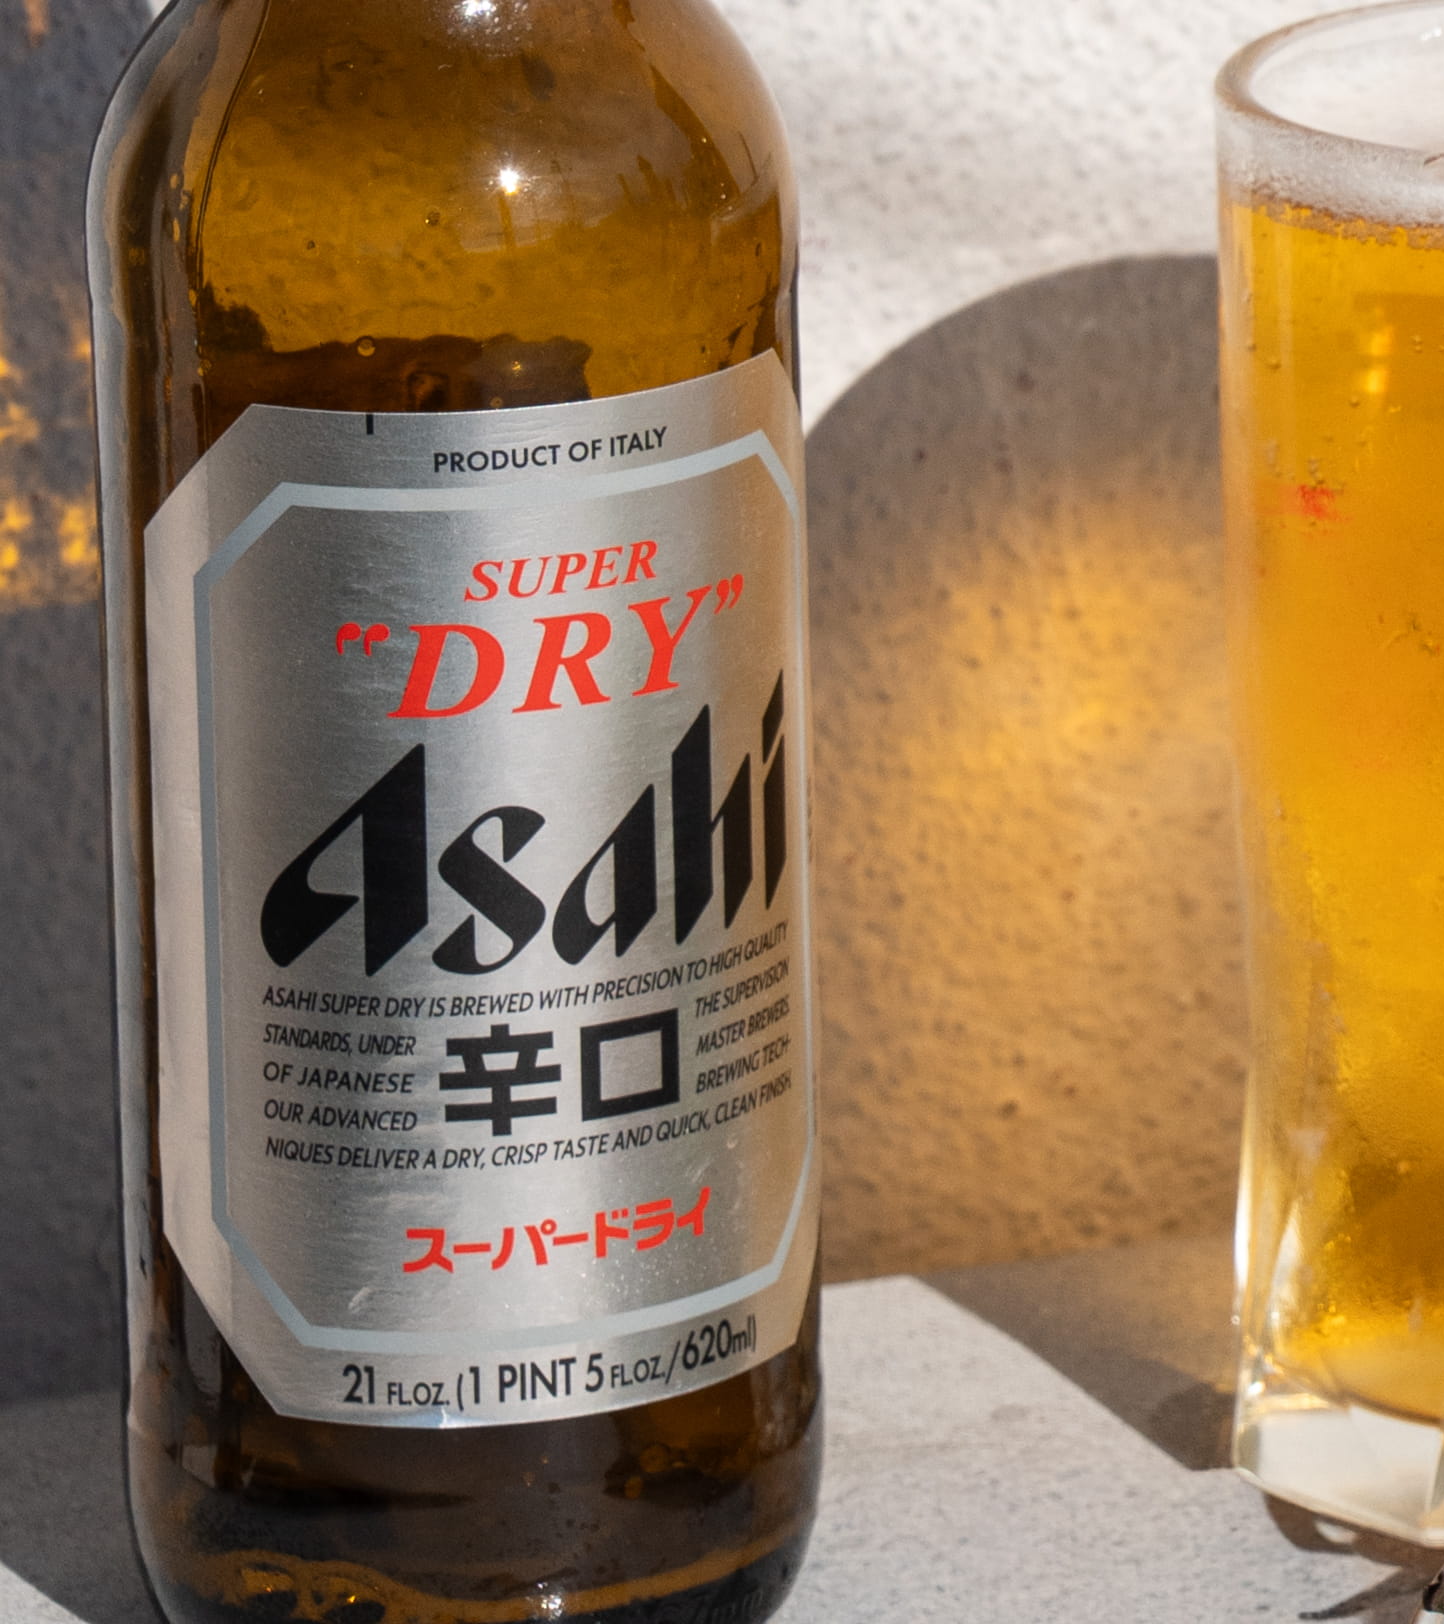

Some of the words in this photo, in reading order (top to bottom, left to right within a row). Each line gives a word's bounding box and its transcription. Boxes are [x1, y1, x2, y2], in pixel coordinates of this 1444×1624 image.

[433, 444, 559, 473] PRODUCT
[567, 440, 603, 462] OF
[608, 426, 668, 458] ITALY
[464, 540, 657, 602] SUPER
[260, 668, 787, 977] Asahi
[263, 986, 318, 1011] ASAHI
[320, 992, 379, 1017] SUPER
[384, 997, 426, 1018] DRY
[429, 997, 445, 1017] IS
[450, 992, 533, 1017] BREWED
[539, 985, 589, 1009] WITH
[593, 965, 684, 1003] PRECISION
[687, 958, 707, 983] TO
[709, 947, 742, 976] HIGH
[743, 920, 789, 960] QUALITY
[263, 1023, 351, 1054] STANDARDS,
[358, 1035, 416, 1056] UNDER
[696, 990, 721, 1018] THE
[722, 955, 790, 1009] SUPERVISION
[263, 1061, 293, 1083] OF
[297, 1067, 415, 1093] JAPANESE
[696, 1019, 746, 1055] MASTER
[747, 994, 790, 1036] BREWERS
[264, 1099, 304, 1123] OUR
[308, 1106, 417, 1132] ADVANCED
[696, 1050, 760, 1094] BREWING
[439, 1009, 680, 1136] 辛口
[266, 1136, 335, 1166] NIQUES
[338, 1147, 420, 1169] DELIVER
[423, 1149, 437, 1169] A
[442, 1147, 485, 1171] DRY,
[491, 1142, 548, 1167] CRISP
[553, 1133, 609, 1161] TASTE
[612, 1125, 653, 1152] AND
[656, 1111, 712, 1142] QUICK,
[714, 1088, 757, 1125] CLEAN
[759, 1070, 792, 1107] FINISH
[402, 1186, 711, 1274] スーパードライ
[342, 1363, 375, 1404] 21
[457, 1366, 480, 1412] (1
[499, 1357, 577, 1403] PINT
[585, 1352, 604, 1393] 5
